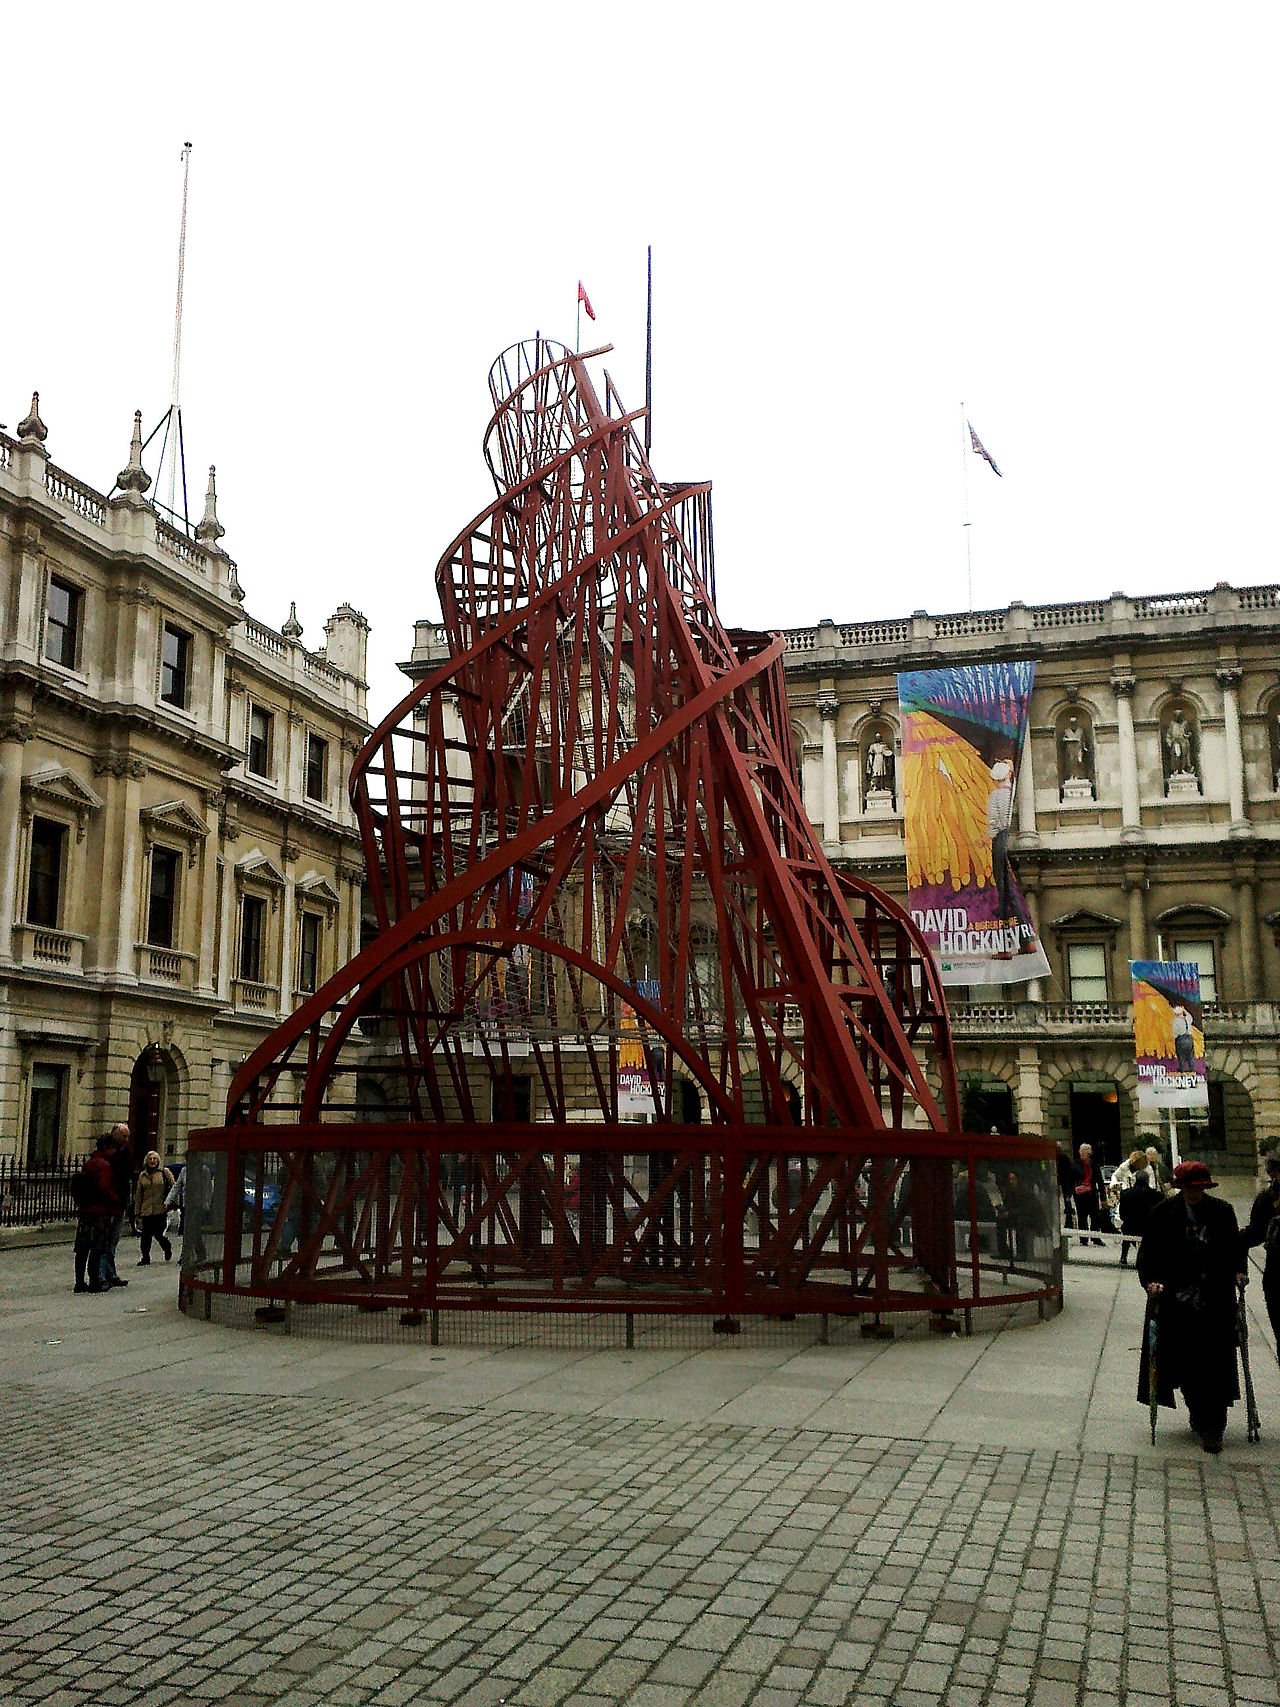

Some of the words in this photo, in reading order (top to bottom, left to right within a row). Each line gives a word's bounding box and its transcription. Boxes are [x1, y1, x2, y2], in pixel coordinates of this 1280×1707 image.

[911, 908, 967, 932] DAVID
[940, 926, 1020, 955] HOCKNEY
[1138, 1064, 1166, 1076] DAVID
[620, 1074, 642, 1085] DAVID
[1152, 1075, 1197, 1087] HOCKNEY
[630, 1084, 666, 1096] HOCKY
